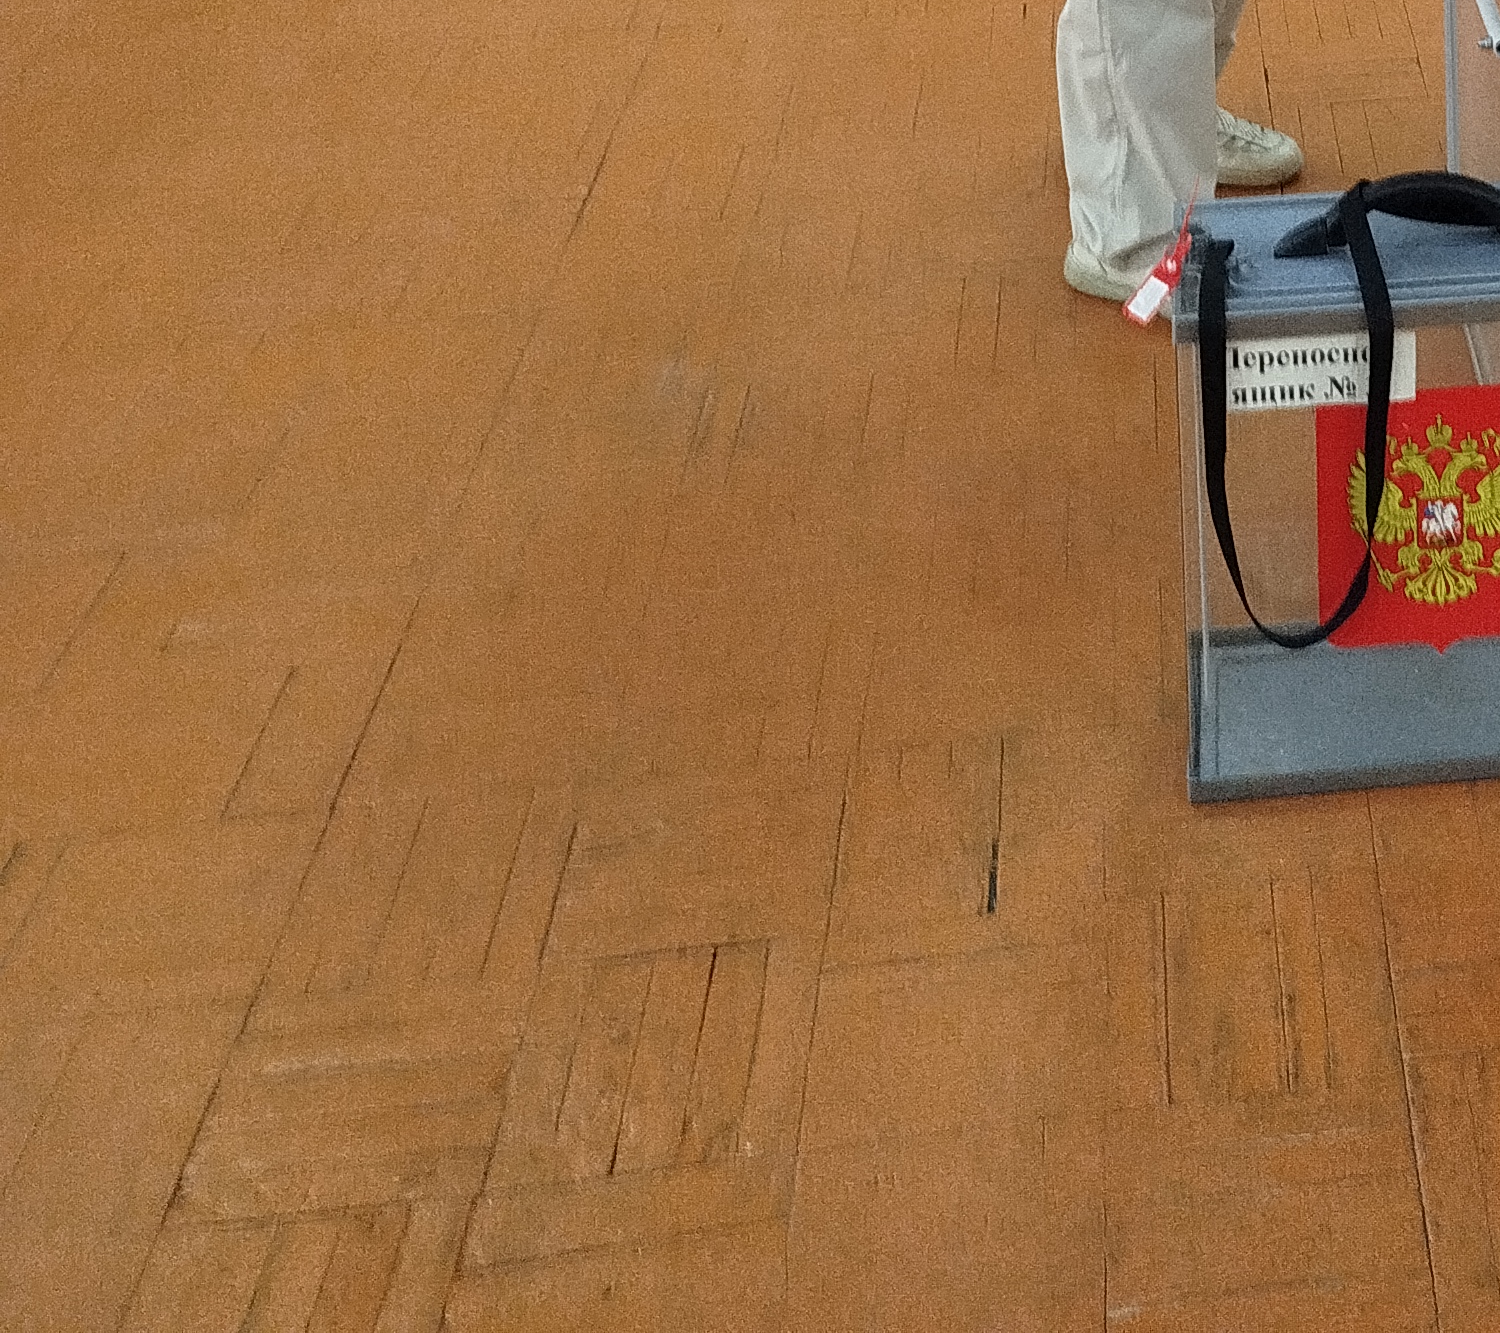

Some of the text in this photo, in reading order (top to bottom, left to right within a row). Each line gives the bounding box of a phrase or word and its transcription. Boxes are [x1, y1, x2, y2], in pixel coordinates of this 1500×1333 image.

[1232, 345, 1368, 375] ереносн
[1231, 375, 1357, 406] ящик №
